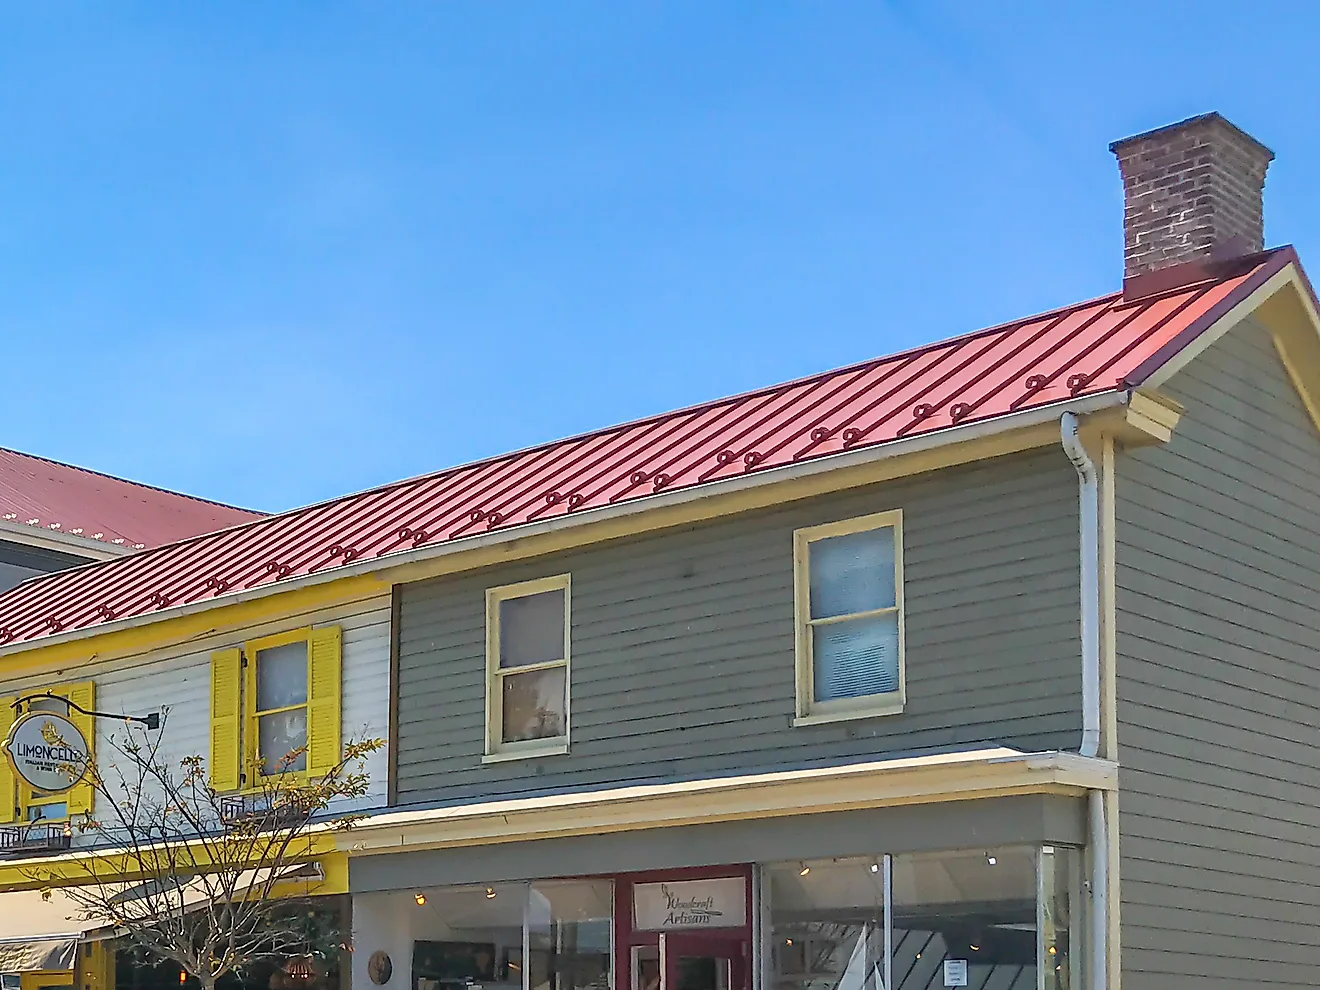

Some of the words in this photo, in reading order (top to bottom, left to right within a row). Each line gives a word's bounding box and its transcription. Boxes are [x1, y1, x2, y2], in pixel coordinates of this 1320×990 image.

[17, 743, 83, 763] LIMONCELLO
[663, 887, 713, 910] Woodcraft
[663, 912, 711, 925] Artisans
